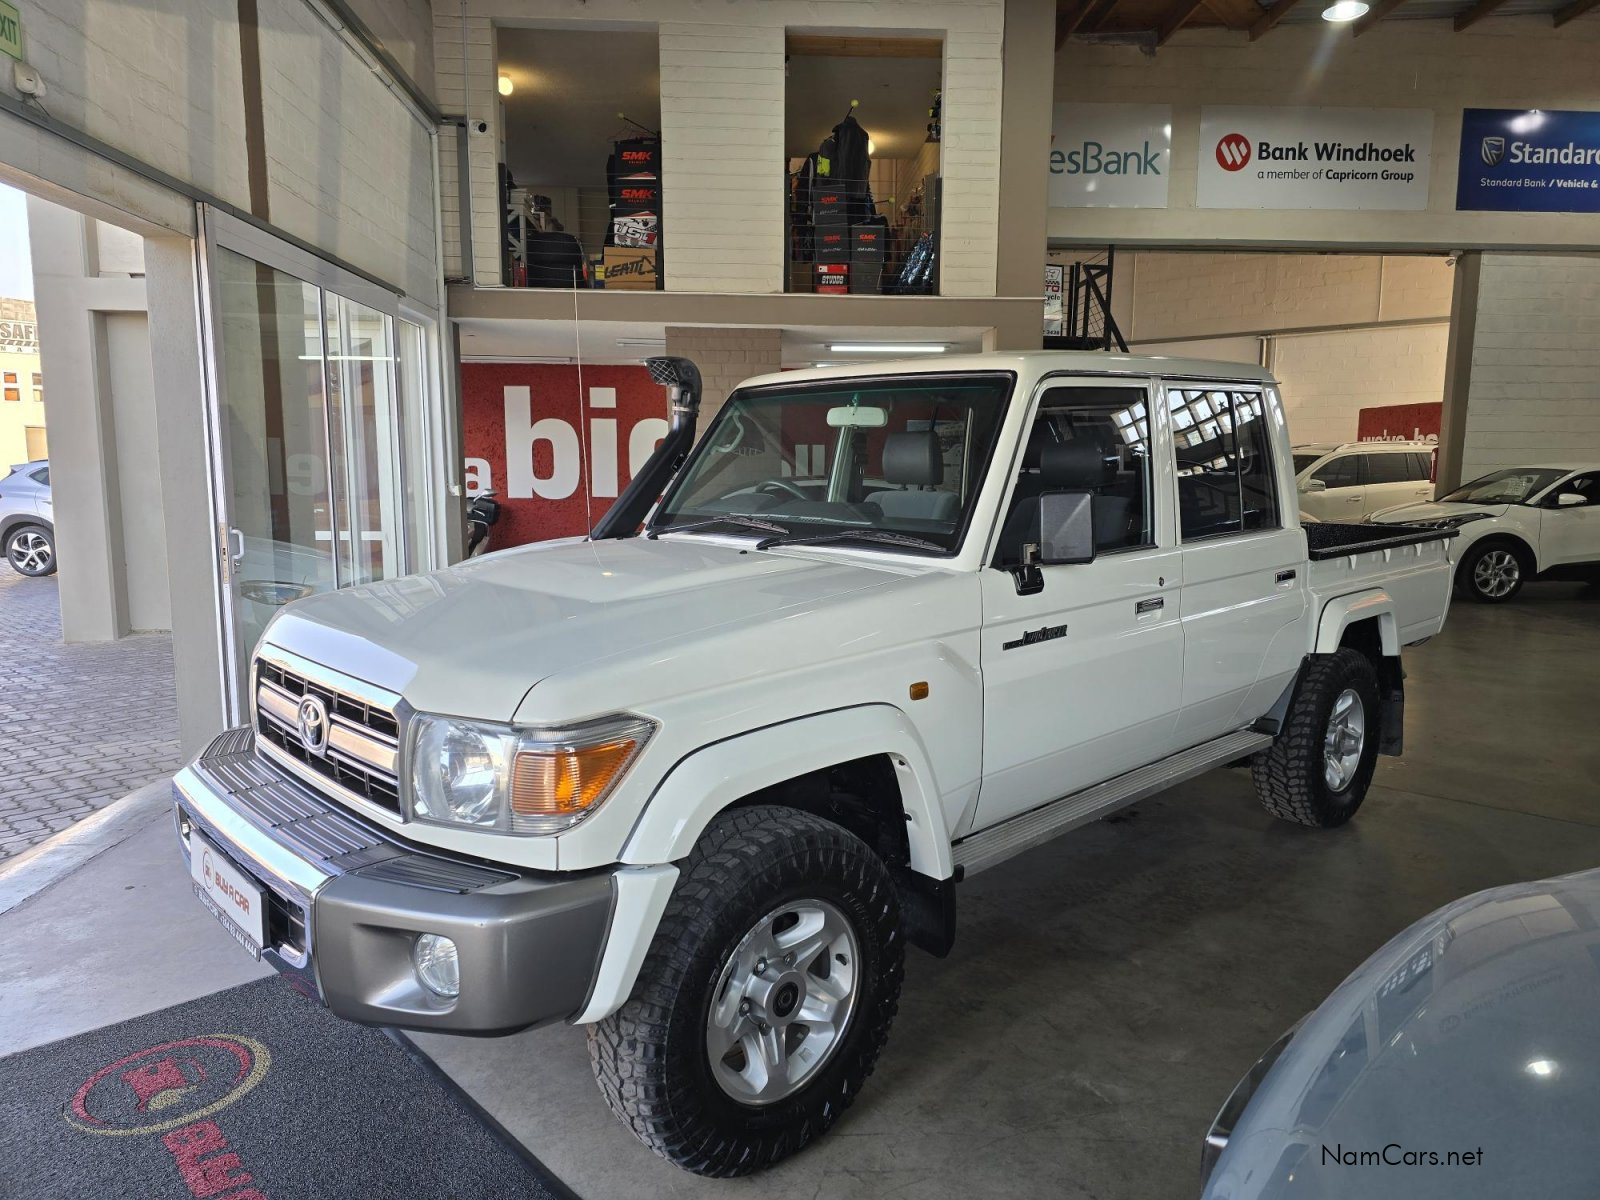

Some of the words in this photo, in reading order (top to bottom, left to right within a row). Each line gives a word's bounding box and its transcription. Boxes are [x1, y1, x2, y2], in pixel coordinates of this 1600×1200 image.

[621, 151, 653, 160] SMK
[1257, 141, 1309, 161] Bank
[1314, 142, 1415, 162] Windhoek
[1257, 170, 1264, 179] a
[1267, 168, 1310, 180] member
[1312, 168, 1324, 180] of
[1325, 168, 1378, 183] Capricorn
[1381, 169, 1414, 184] Group
[1480, 178, 1522, 188] Standard
[1524, 178, 1546, 188] Bank
[1556, 179, 1589, 189] Vehicle
[1590, 179, 1598, 189] &
[621, 189, 654, 199] SMK
